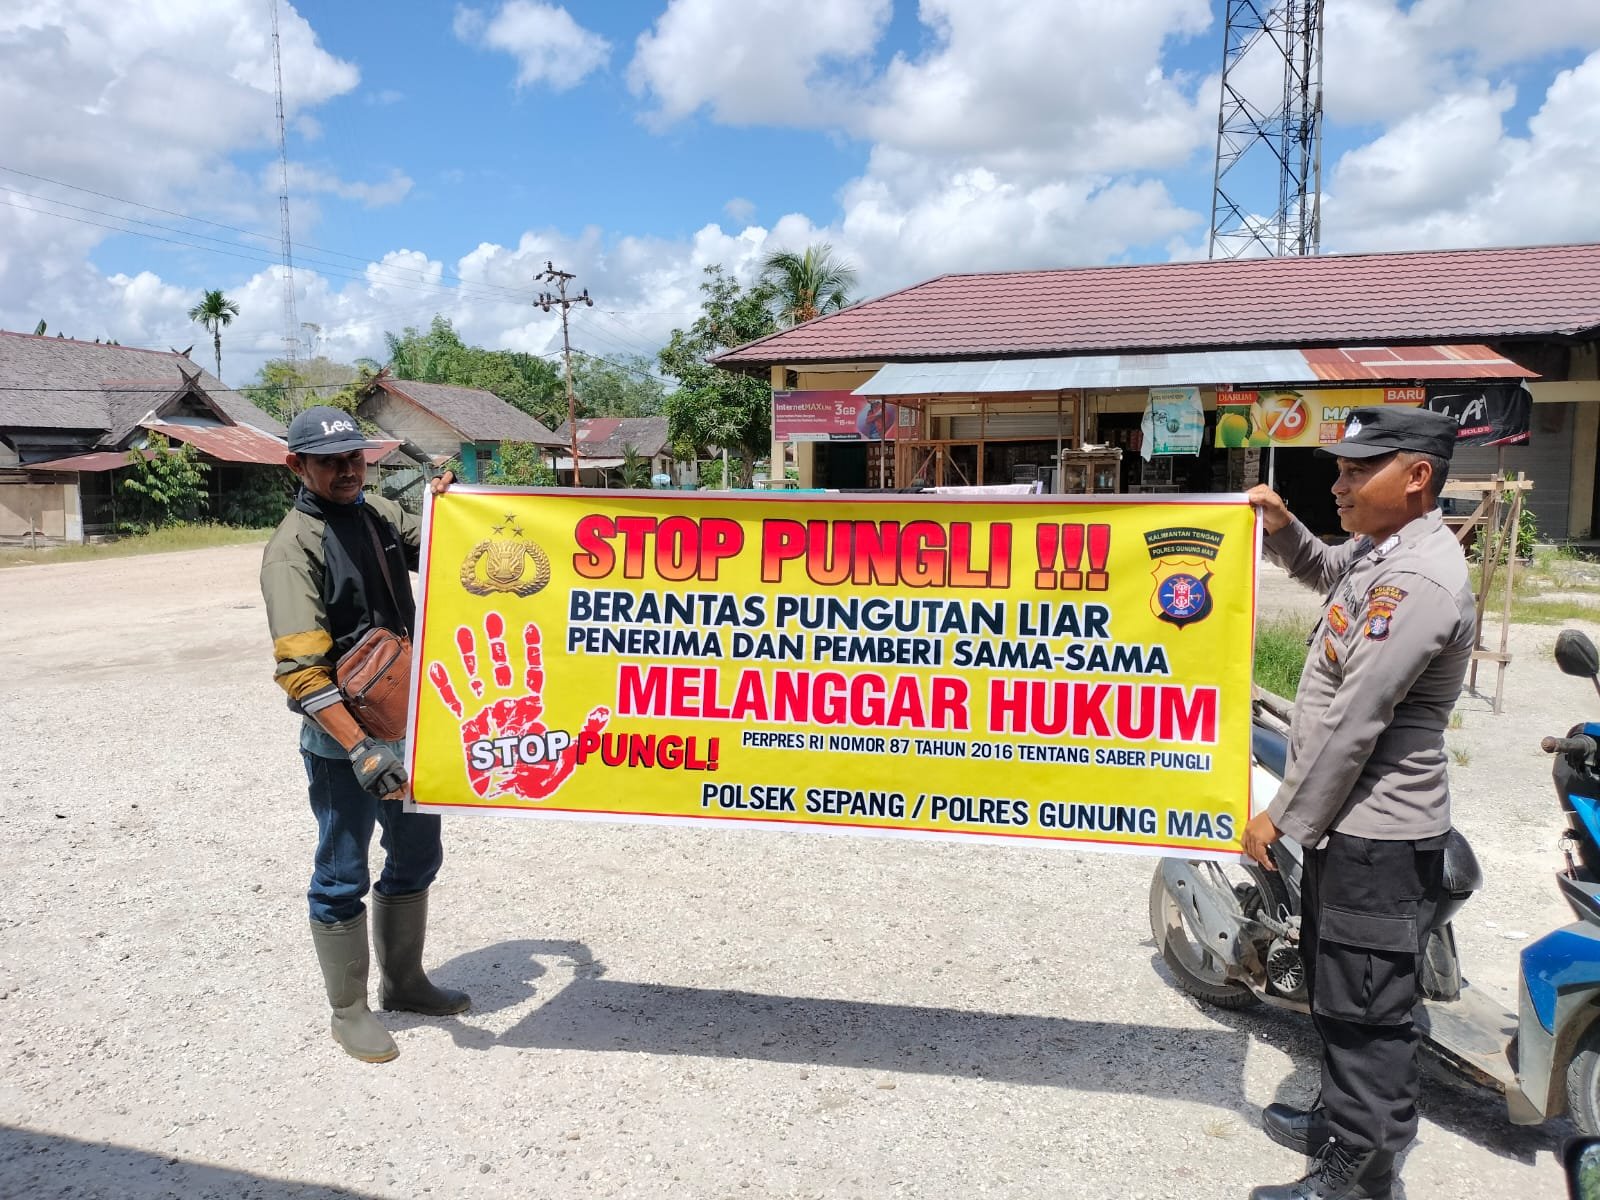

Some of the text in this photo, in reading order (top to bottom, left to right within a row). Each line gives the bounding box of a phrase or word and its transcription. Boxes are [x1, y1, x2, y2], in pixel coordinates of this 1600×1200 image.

[1387, 389, 1424, 400] BARU
[321, 420, 353, 436] Lee
[1268, 399, 1301, 436] 76
[572, 514, 1111, 591] STOP PUNGLI !!!
[1147, 531, 1220, 542] KALIMANTAN TENGAH
[570, 591, 1109, 638] BERANTAS PUNGUTAN LIAR
[568, 628, 1169, 674] PENERIMA DAN PEMBERI SAMA-SAMA
[618, 665, 1217, 743] MELANGGAR HUKUM
[470, 730, 570, 771] STOP
[743, 732, 1211, 771] PERPRES RI NOMOR 87 TAHUN 2016 TENTANG SABER PUNGLI
[702, 783, 795, 812] POLSEK
[806, 787, 904, 818] SEPANG
[931, 796, 1028, 826] POLRES
[1040, 804, 1156, 836] GUNUNG
[1167, 810, 1233, 840] MAS
